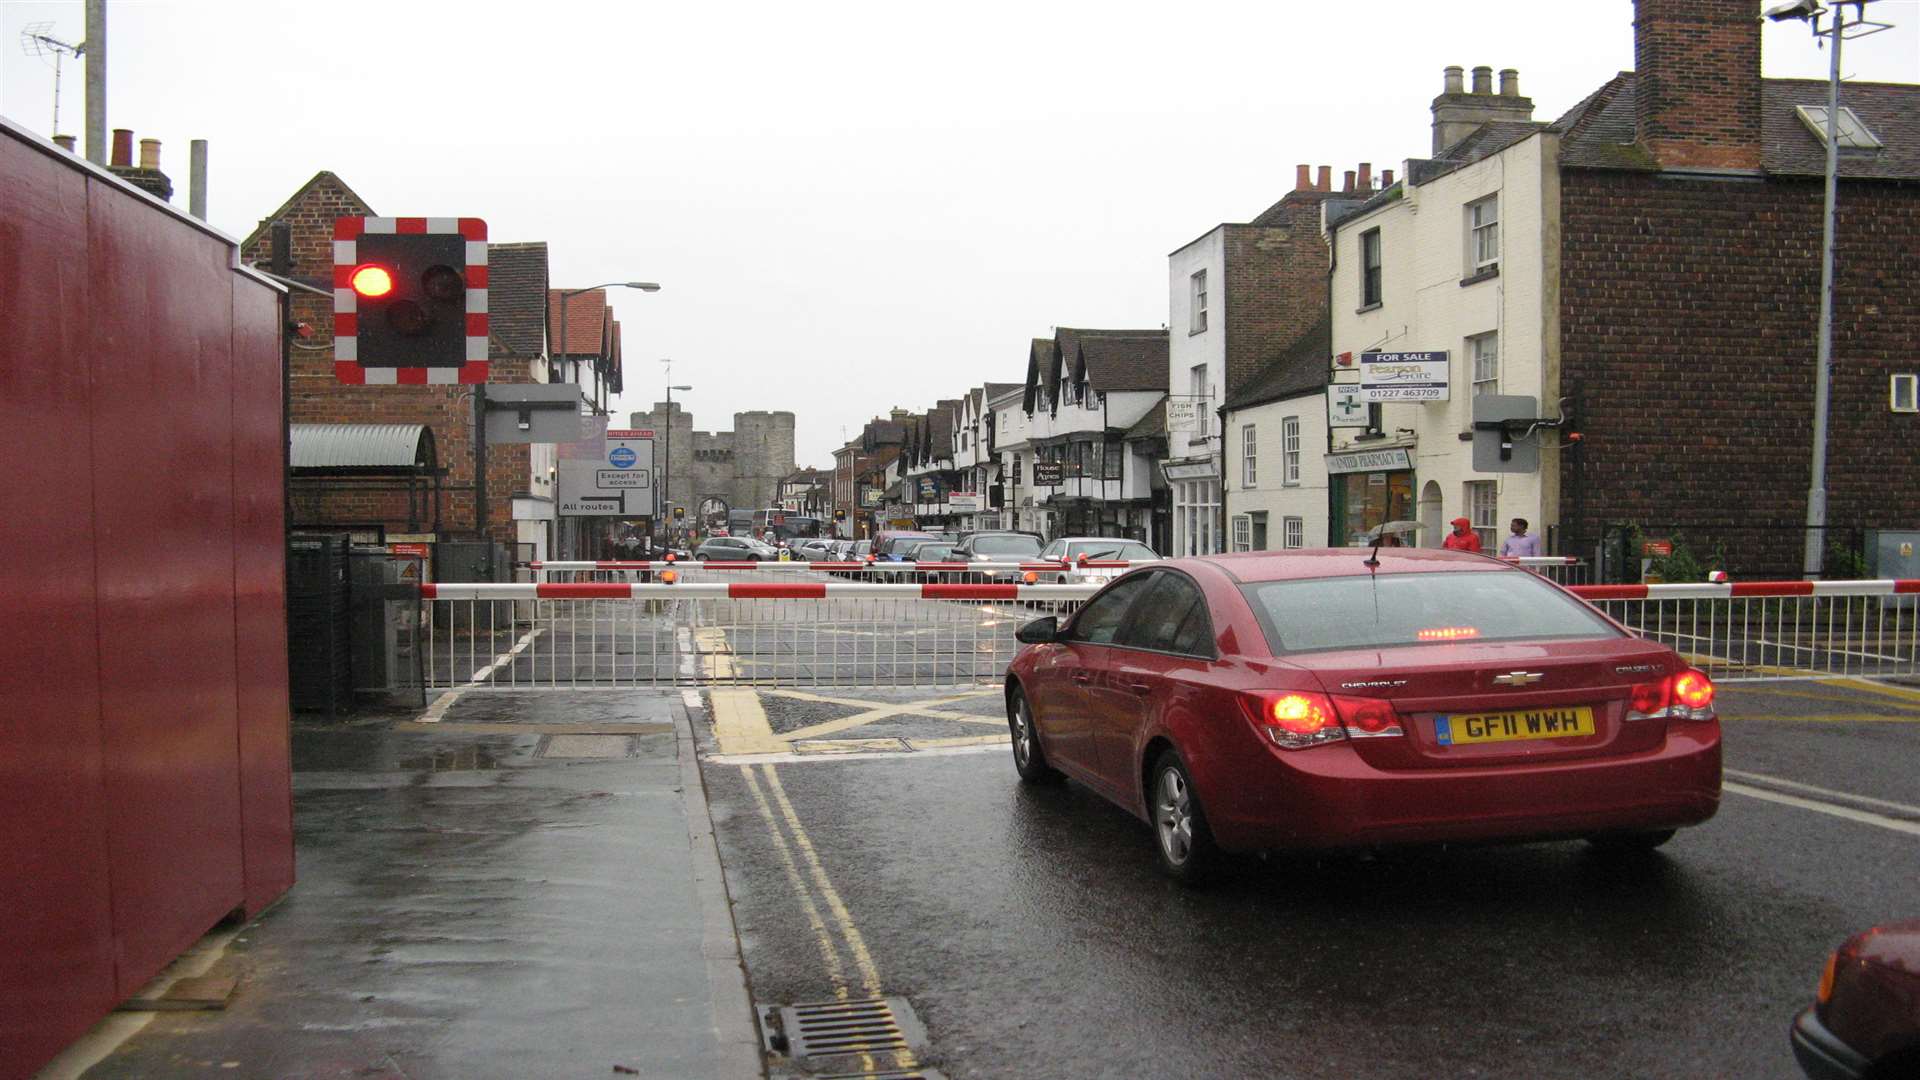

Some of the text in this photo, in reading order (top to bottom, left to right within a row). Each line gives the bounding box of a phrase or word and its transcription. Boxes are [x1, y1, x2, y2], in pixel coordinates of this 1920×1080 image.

[1370, 390, 1399, 398] 01227
[1359, 452, 1395, 467] PHARMACY
[601, 472, 629, 480] Except
[562, 503, 614, 511] All routes
[1342, 680, 1407, 688] CHEVROLET
[1466, 711, 1578, 738] GF11 WWH
